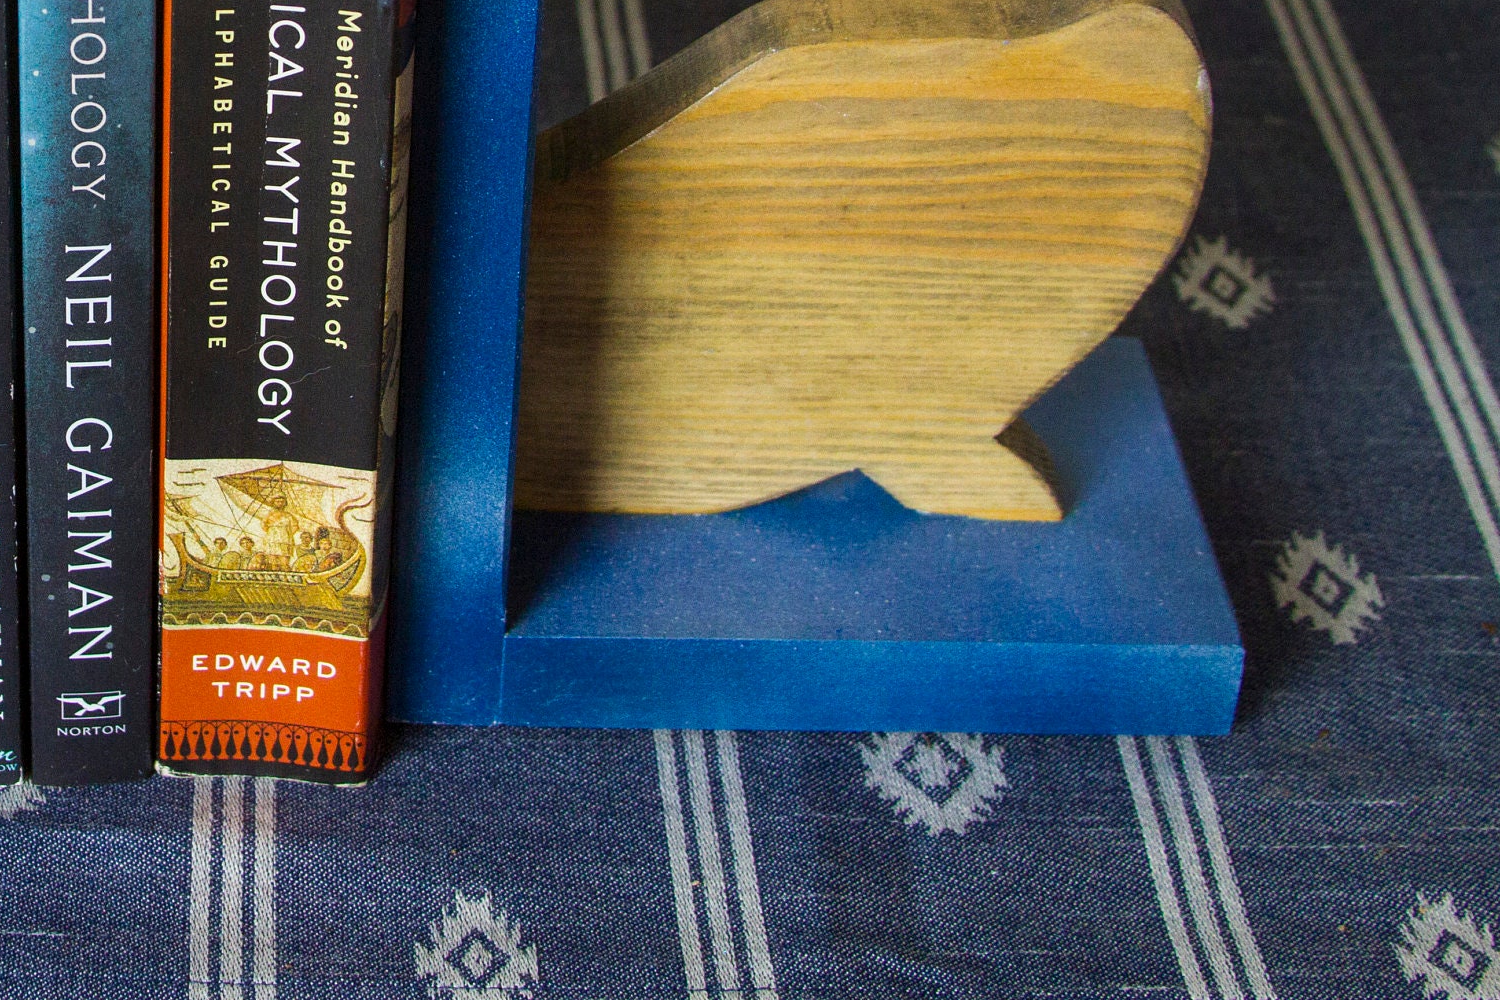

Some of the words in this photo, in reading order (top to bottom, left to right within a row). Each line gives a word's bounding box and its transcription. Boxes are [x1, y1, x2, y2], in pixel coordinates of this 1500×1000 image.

[332, 9, 363, 146] Meridian
[256, 136, 303, 436] MYTHOLOGY
[325, 158, 356, 309] Handbook
[64, 242, 113, 390] NEIL
[207, 255, 230, 350] GUIDE
[323, 318, 348, 351] of
[64, 417, 114, 661] GAIMAN
[191, 653, 337, 680] EDWARD
[211, 681, 315, 703] TRIPP
[56, 724, 127, 737] NORTON
